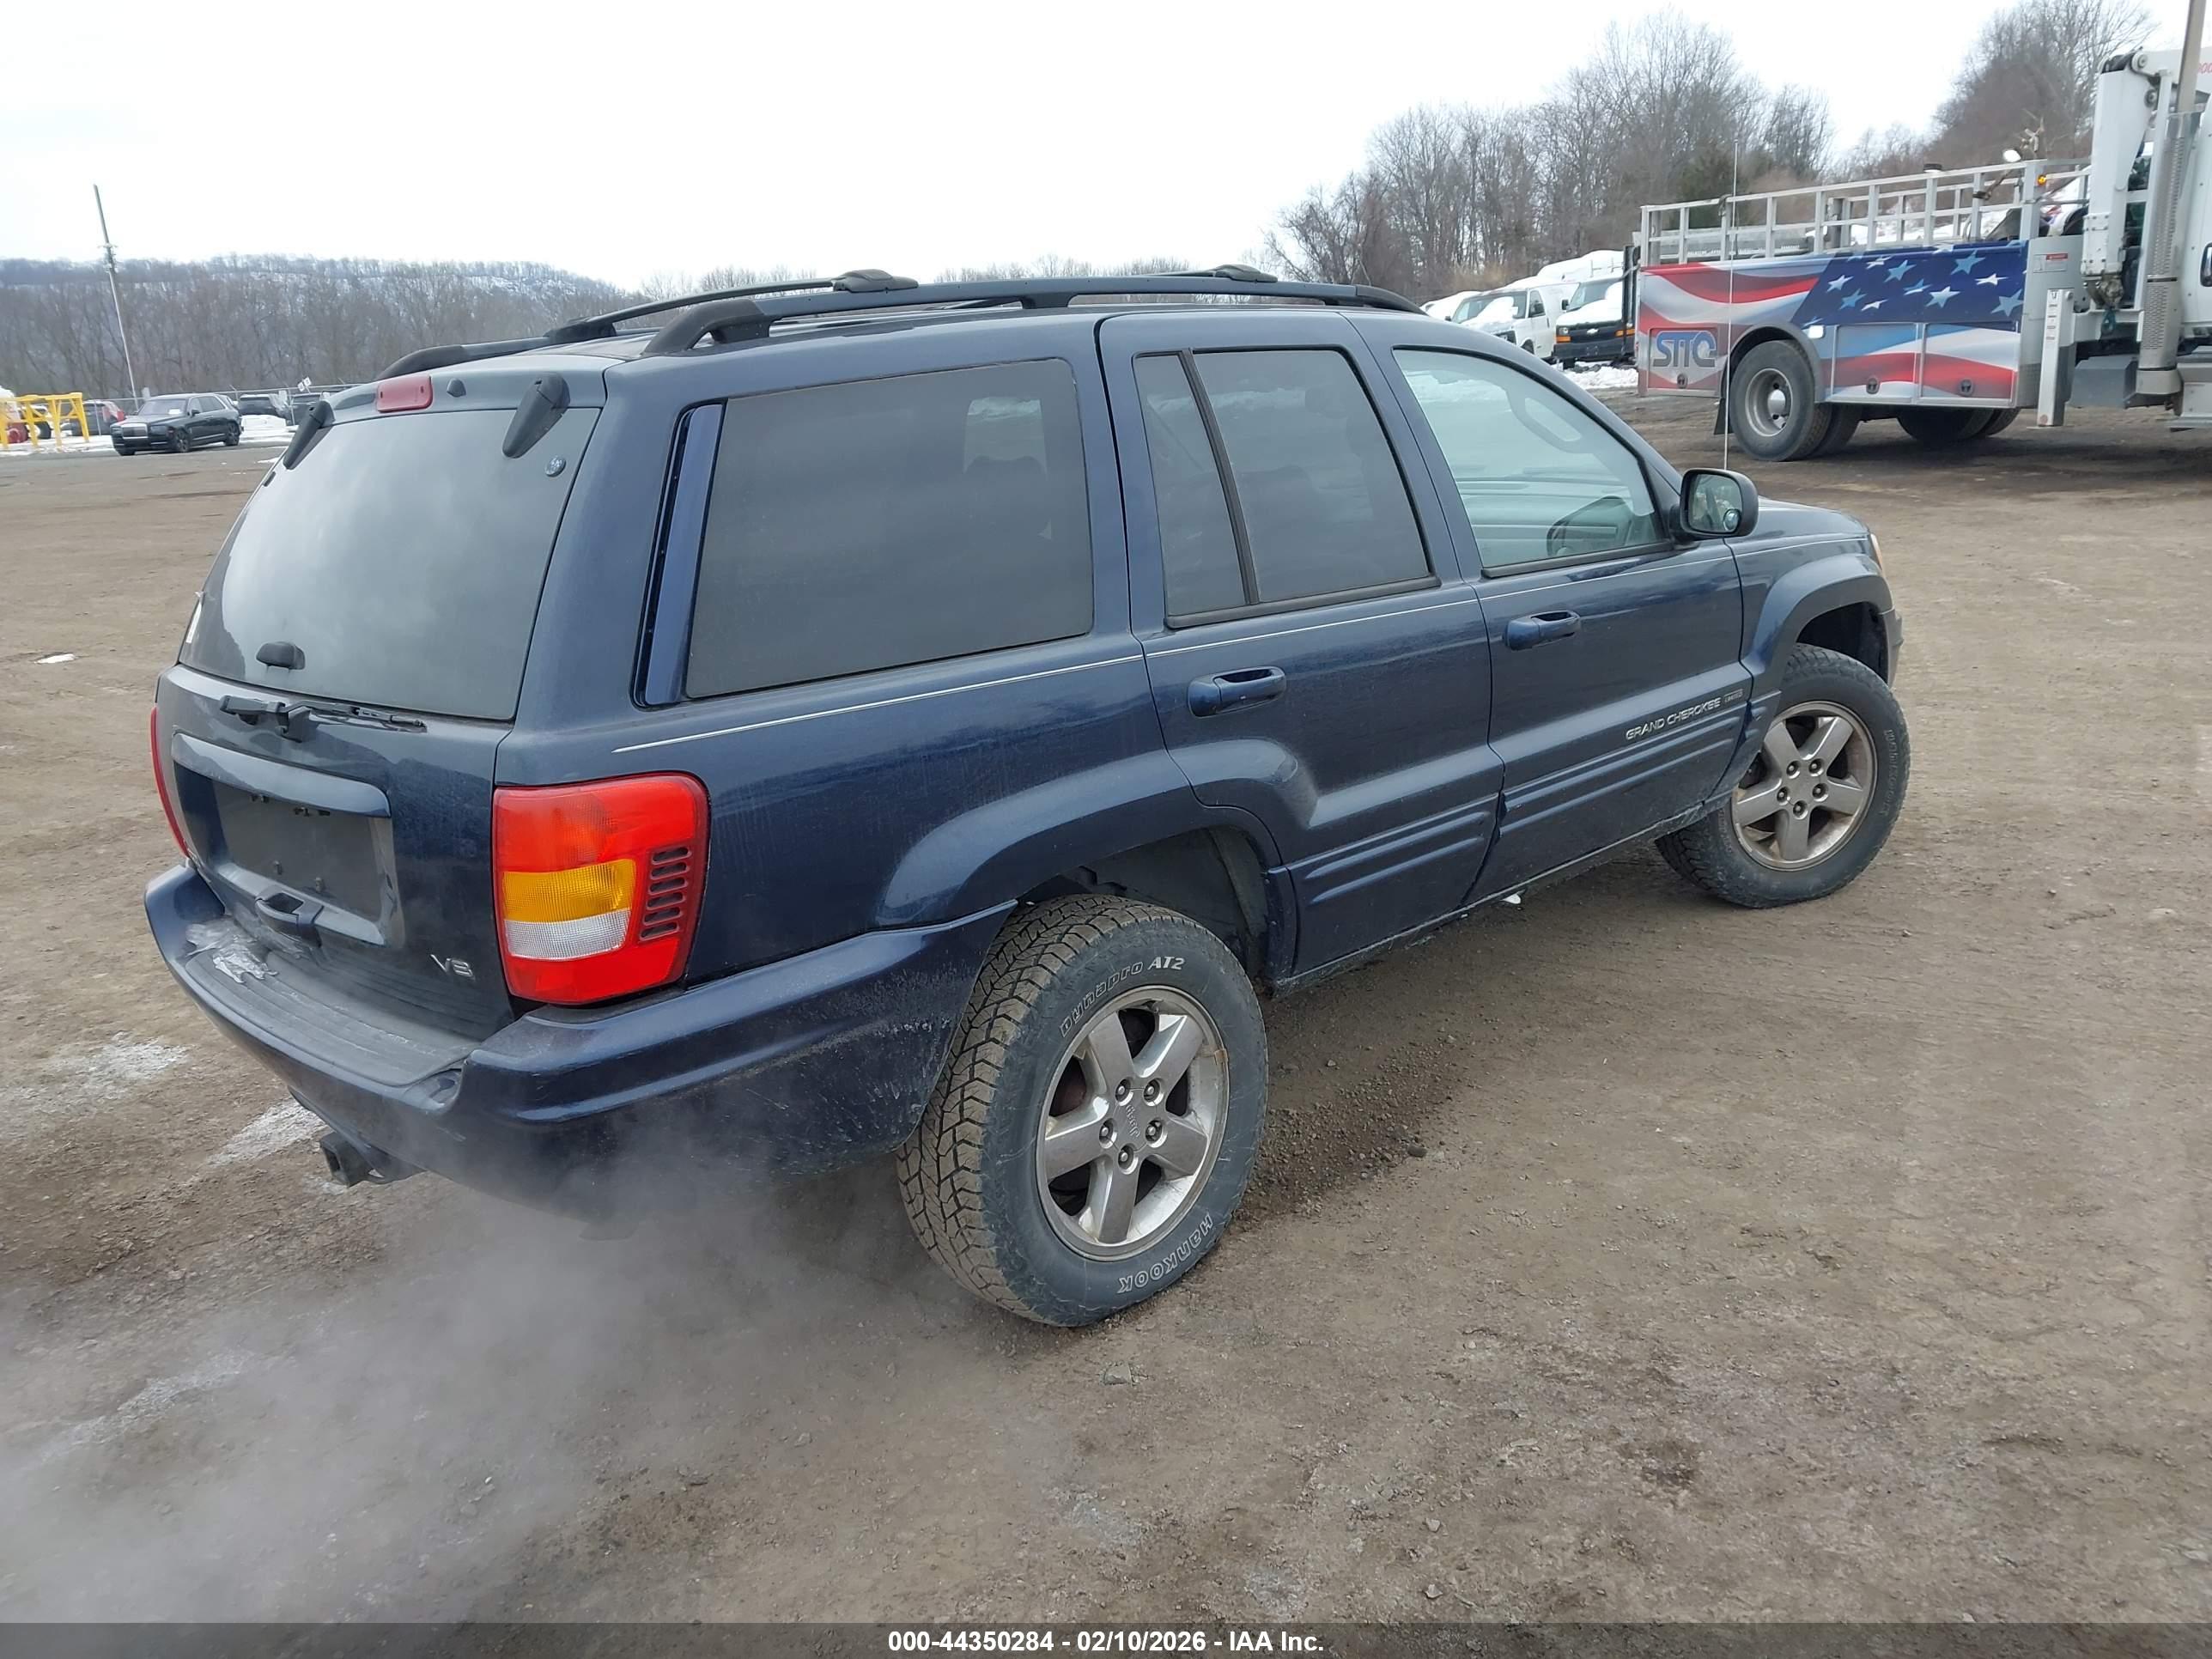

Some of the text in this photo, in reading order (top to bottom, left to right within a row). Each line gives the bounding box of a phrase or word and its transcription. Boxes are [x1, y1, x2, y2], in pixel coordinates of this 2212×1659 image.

[1626, 718, 1665, 739] GRAND
[1667, 697, 1722, 725] CHEROKEE
[430, 954, 476, 979] V8
[1147, 956, 1185, 970] AT2
